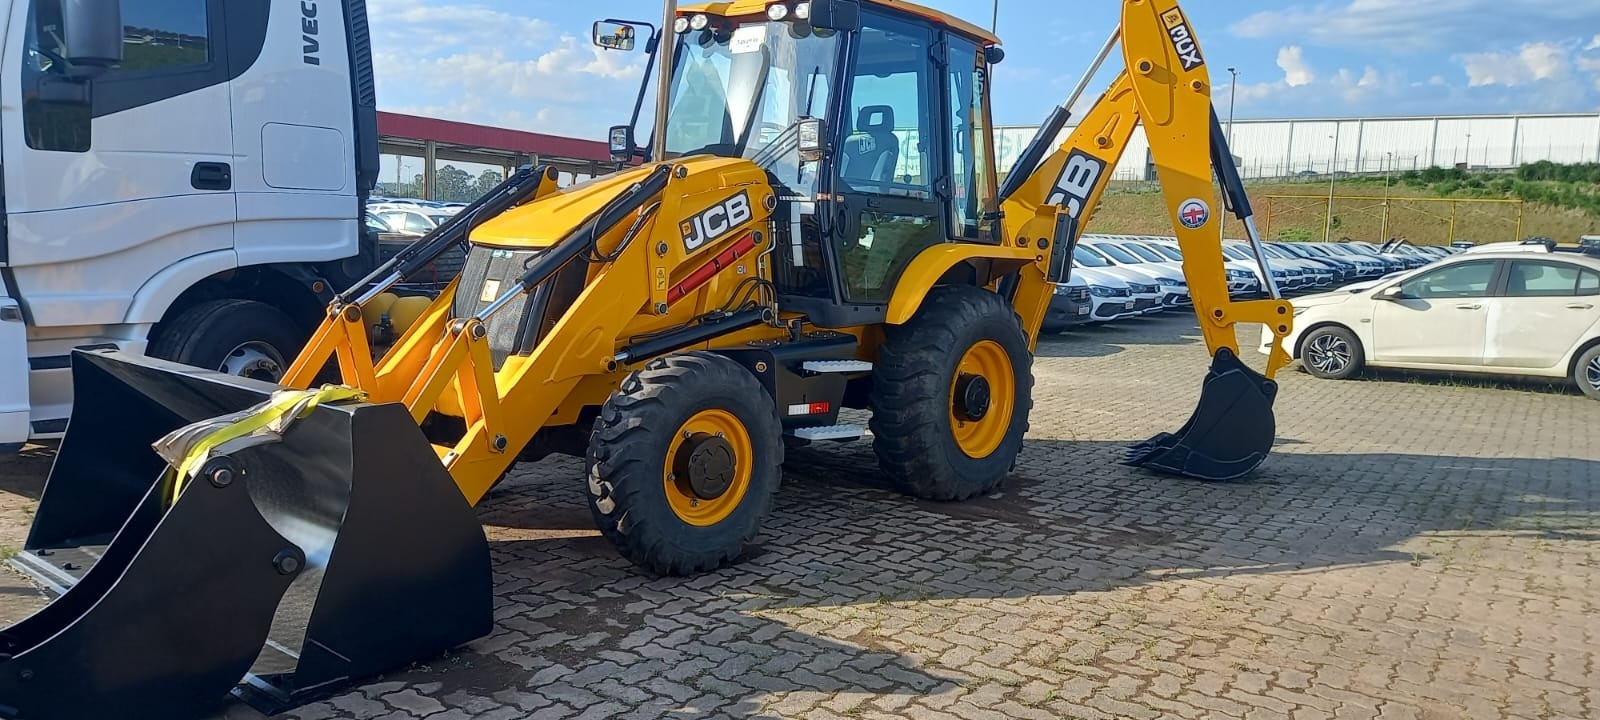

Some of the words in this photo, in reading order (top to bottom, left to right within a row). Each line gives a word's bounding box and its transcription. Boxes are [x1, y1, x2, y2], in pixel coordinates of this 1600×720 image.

[301, 0, 320, 66] IVEC
[1170, 25, 1203, 69] 3CX
[685, 193, 751, 250] JCB
